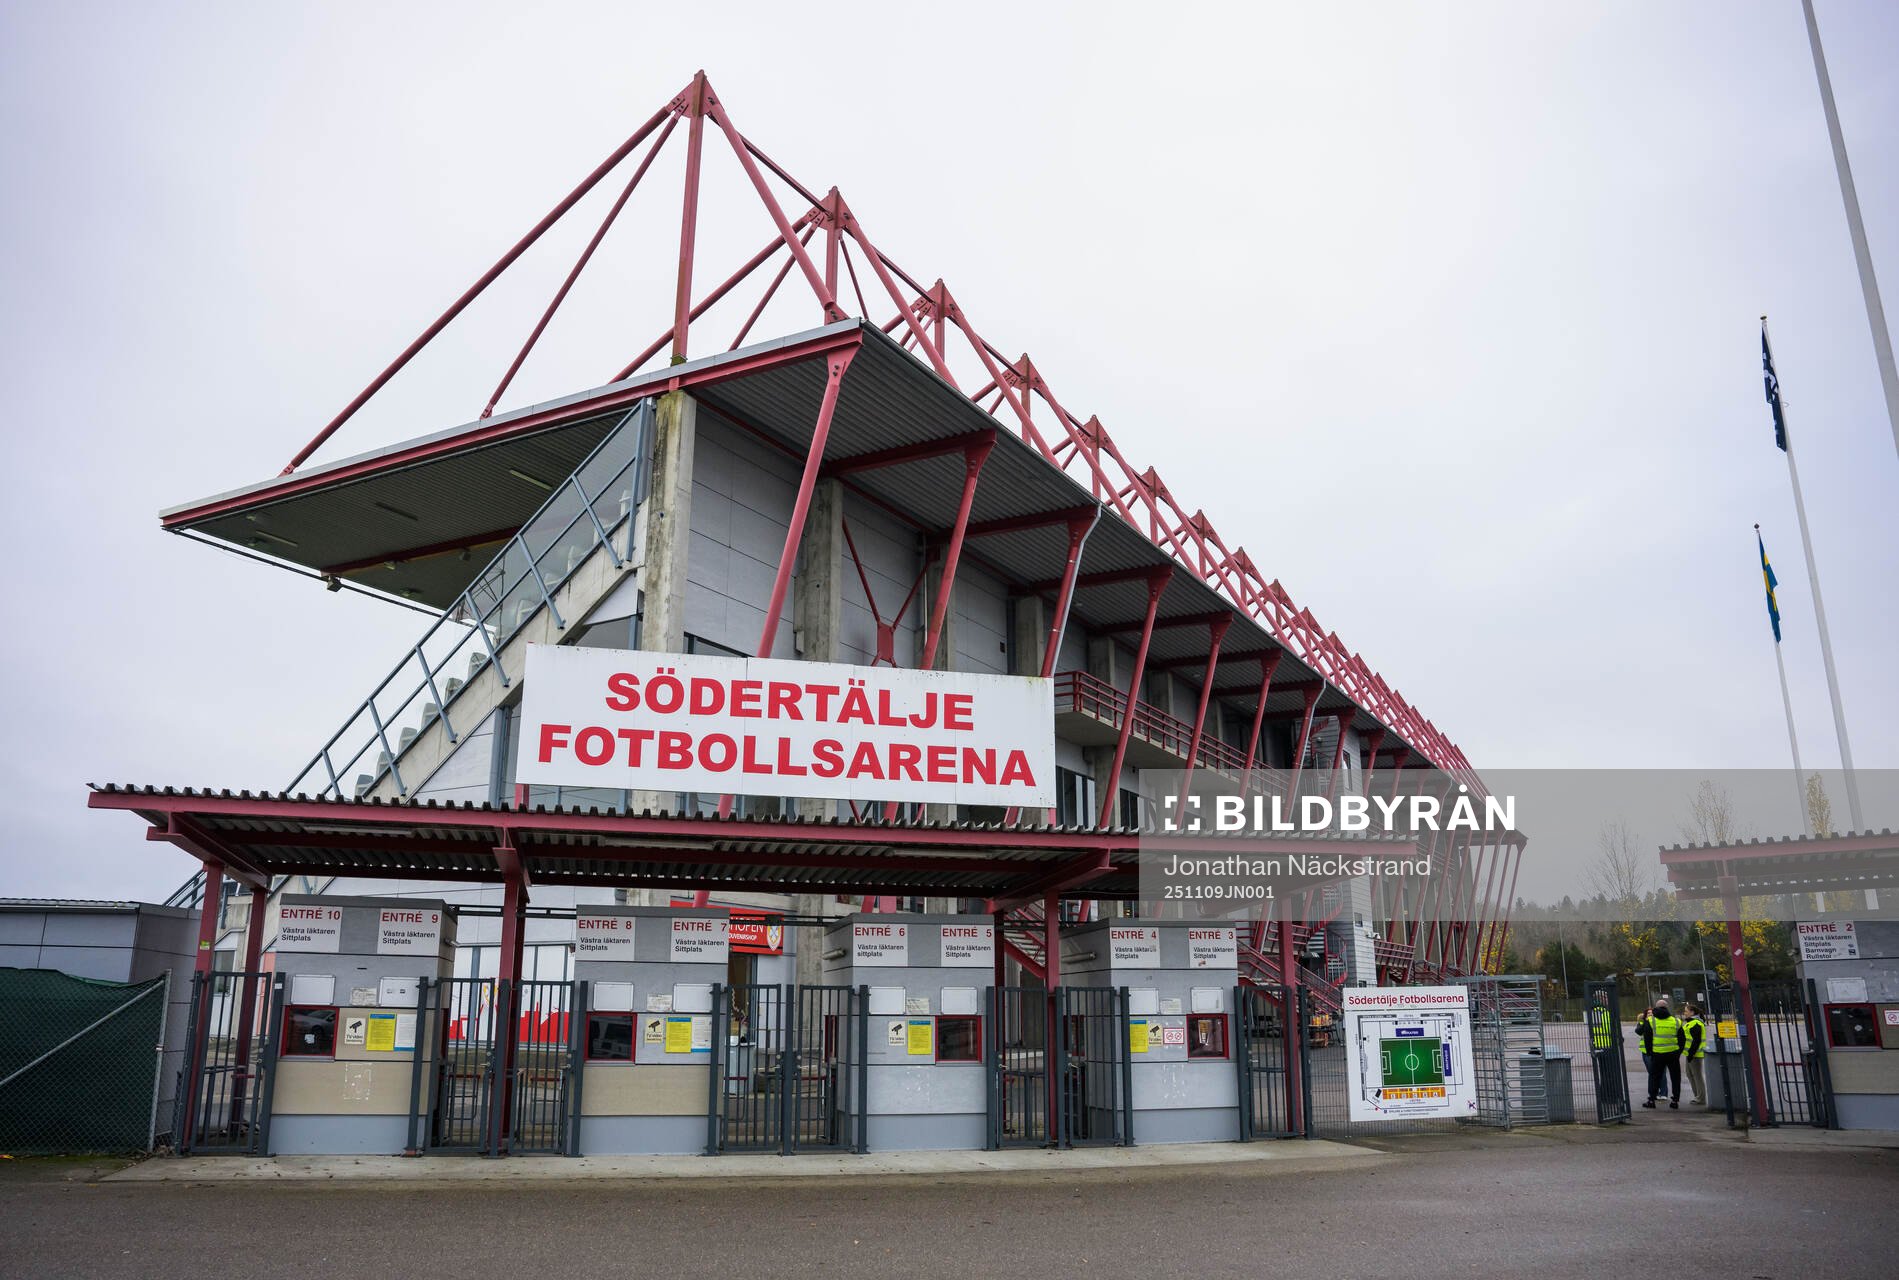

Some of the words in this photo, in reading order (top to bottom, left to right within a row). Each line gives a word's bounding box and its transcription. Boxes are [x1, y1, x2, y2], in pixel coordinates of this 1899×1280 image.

[606, 667, 974, 731] SÖDERTÄLJE
[538, 723, 1036, 787] FOTBOLLSARENA
[281, 908, 322, 920] ENTRÉ
[328, 911, 341, 921] 10
[382, 911, 422, 923] ENTRÉ
[431, 914, 438, 923] 9
[578, 918, 618, 930] ENTRÉ
[625, 921, 632, 930] 8
[673, 919, 712, 932] ENTRÉ
[721, 923, 727, 932] 7
[1799, 922, 1837, 933] ENTRÉ
[1846, 923, 1853, 932] 2
[306, 927, 336, 935] läktaren
[854, 925, 891, 937] ENTRÉ
[899, 929, 905, 937] 6
[942, 926, 978, 938] ENTRÉ
[986, 929, 992, 938] 5
[1111, 929, 1144, 940] ENTRÉ
[1151, 931, 1157, 940] 4
[1189, 929, 1221, 940] ENTRÉ
[1228, 931, 1234, 940] 3
[281, 934, 311, 942] Sittplats
[382, 937, 412, 945] Sittplats
[580, 944, 608, 952] Sittplats
[1348, 996, 1398, 1006] Södertälje
[1400, 995, 1464, 1004] Fotbollsarena
